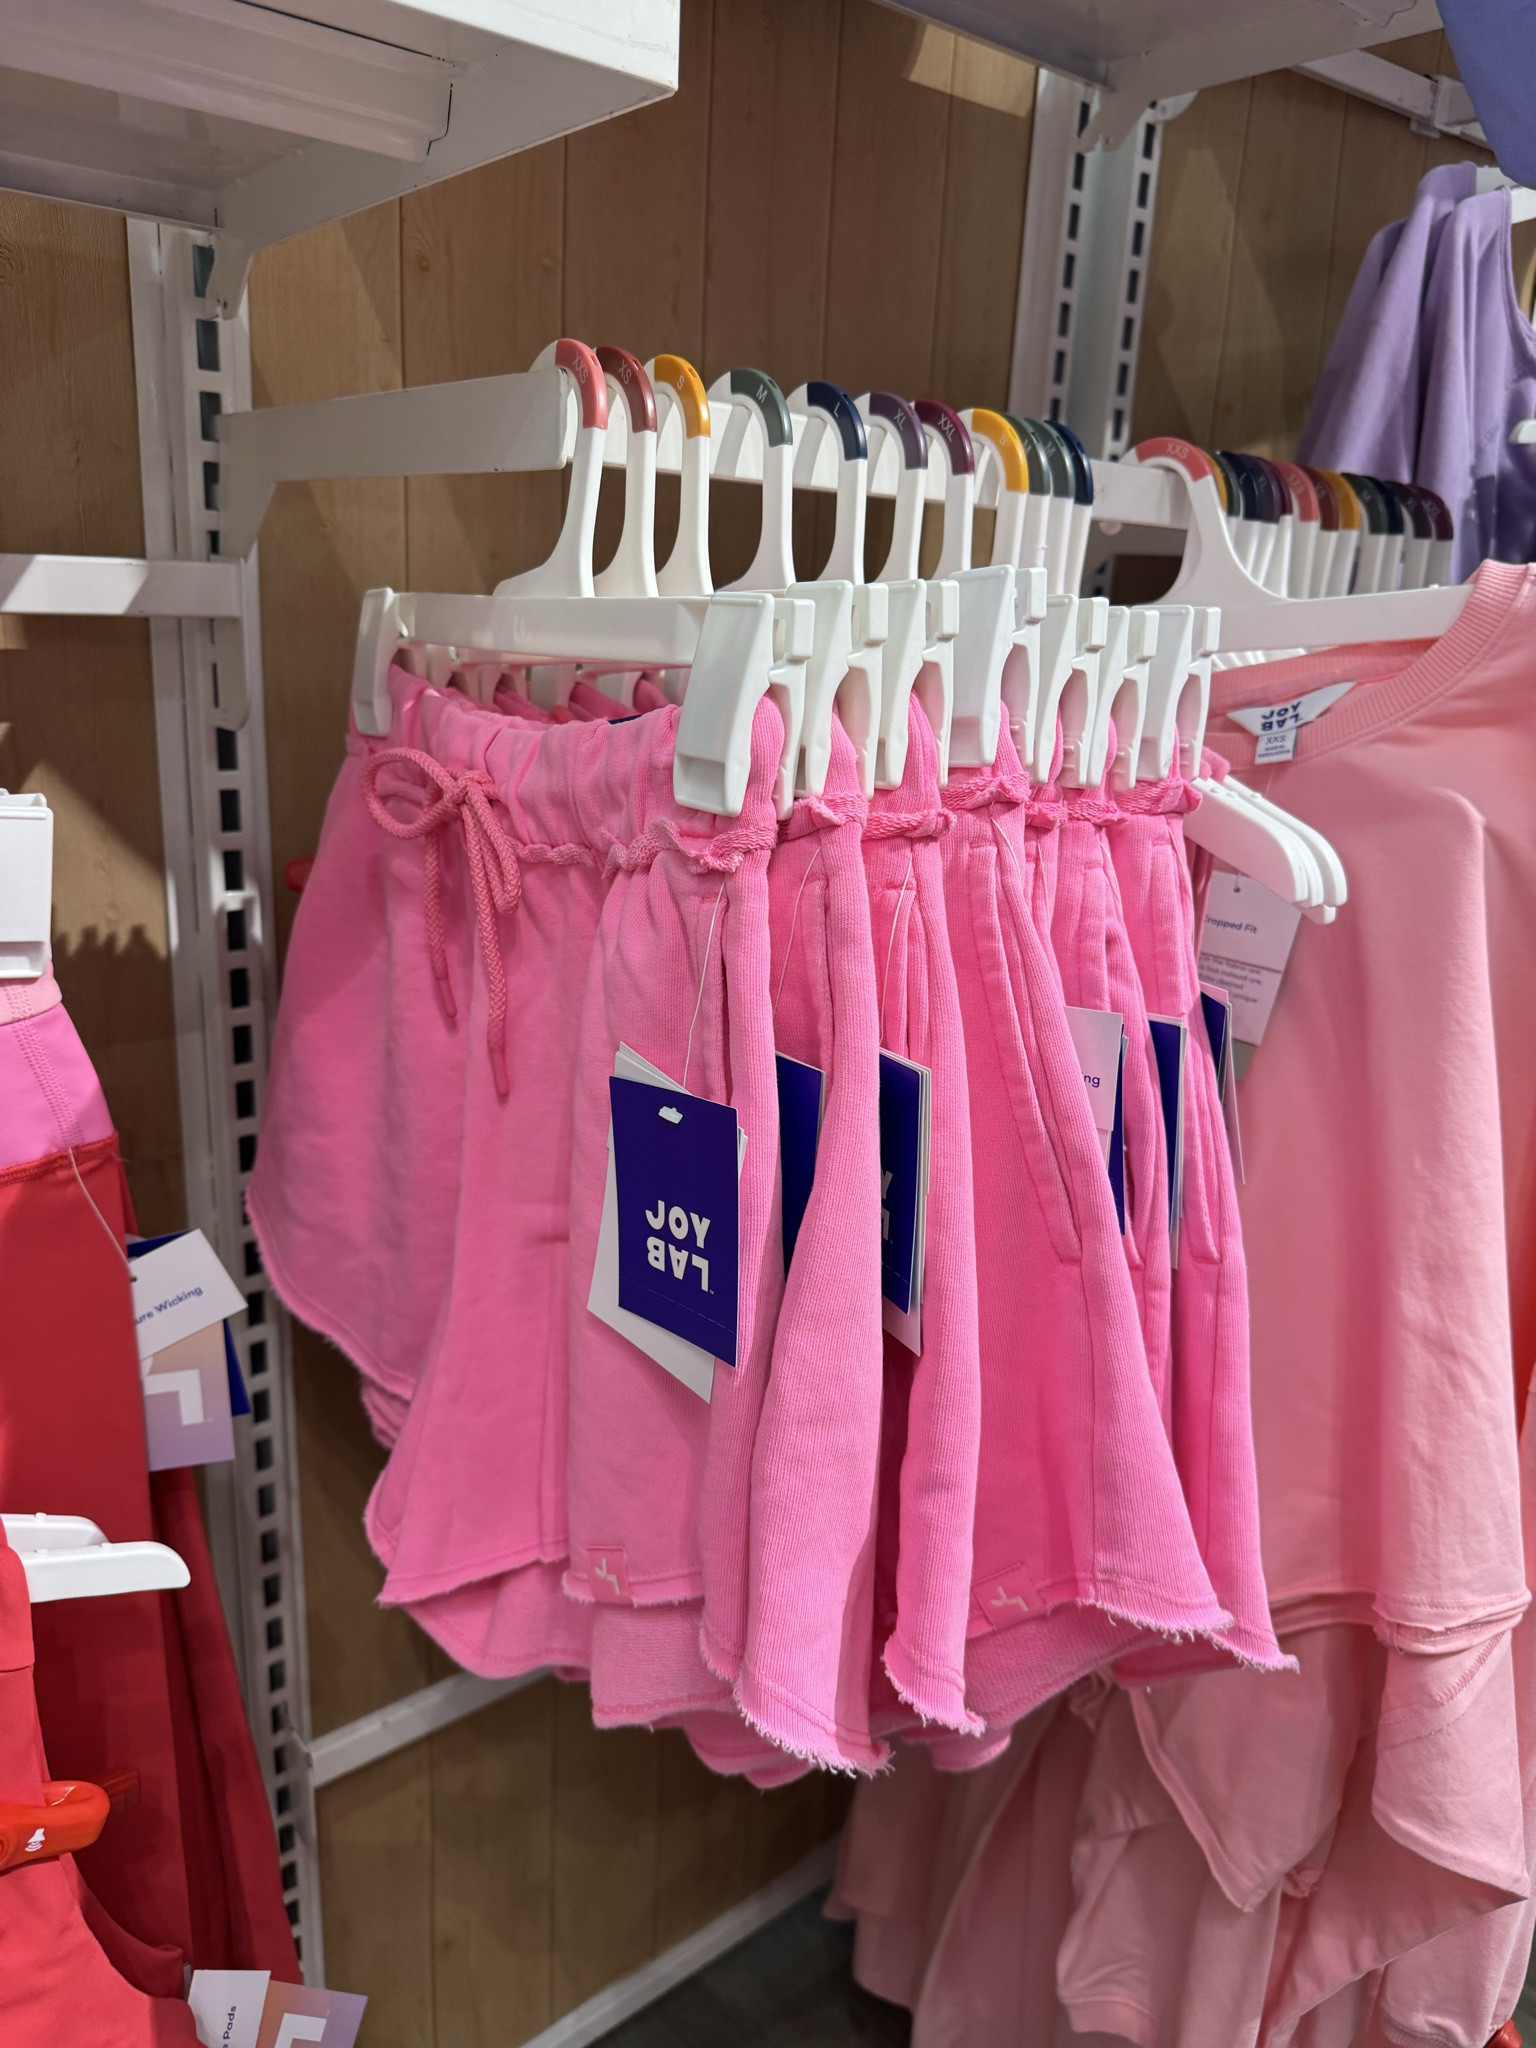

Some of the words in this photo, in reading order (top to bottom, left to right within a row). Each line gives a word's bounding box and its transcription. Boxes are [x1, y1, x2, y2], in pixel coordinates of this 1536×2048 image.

[572, 352, 589, 384] XXS
[618, 358, 632, 384] XS
[676, 375, 685, 390] S
[756, 384, 768, 404] M
[833, 402, 841, 418] L
[893, 408, 907, 431] XL
[938, 413, 956, 442] XXL
[1165, 442, 1189, 459] XXS
[1261, 701, 1302, 720] JOY
[1261, 713, 1300, 732] LAB
[1265, 735, 1287, 745] XXS
[1244, 923, 1258, 934] Fit
[645, 1200, 711, 1249] JOY
[647, 1236, 709, 1292] LAB
[154, 1286, 203, 1312] Wicking
[222, 2005, 237, 2040] Pads
